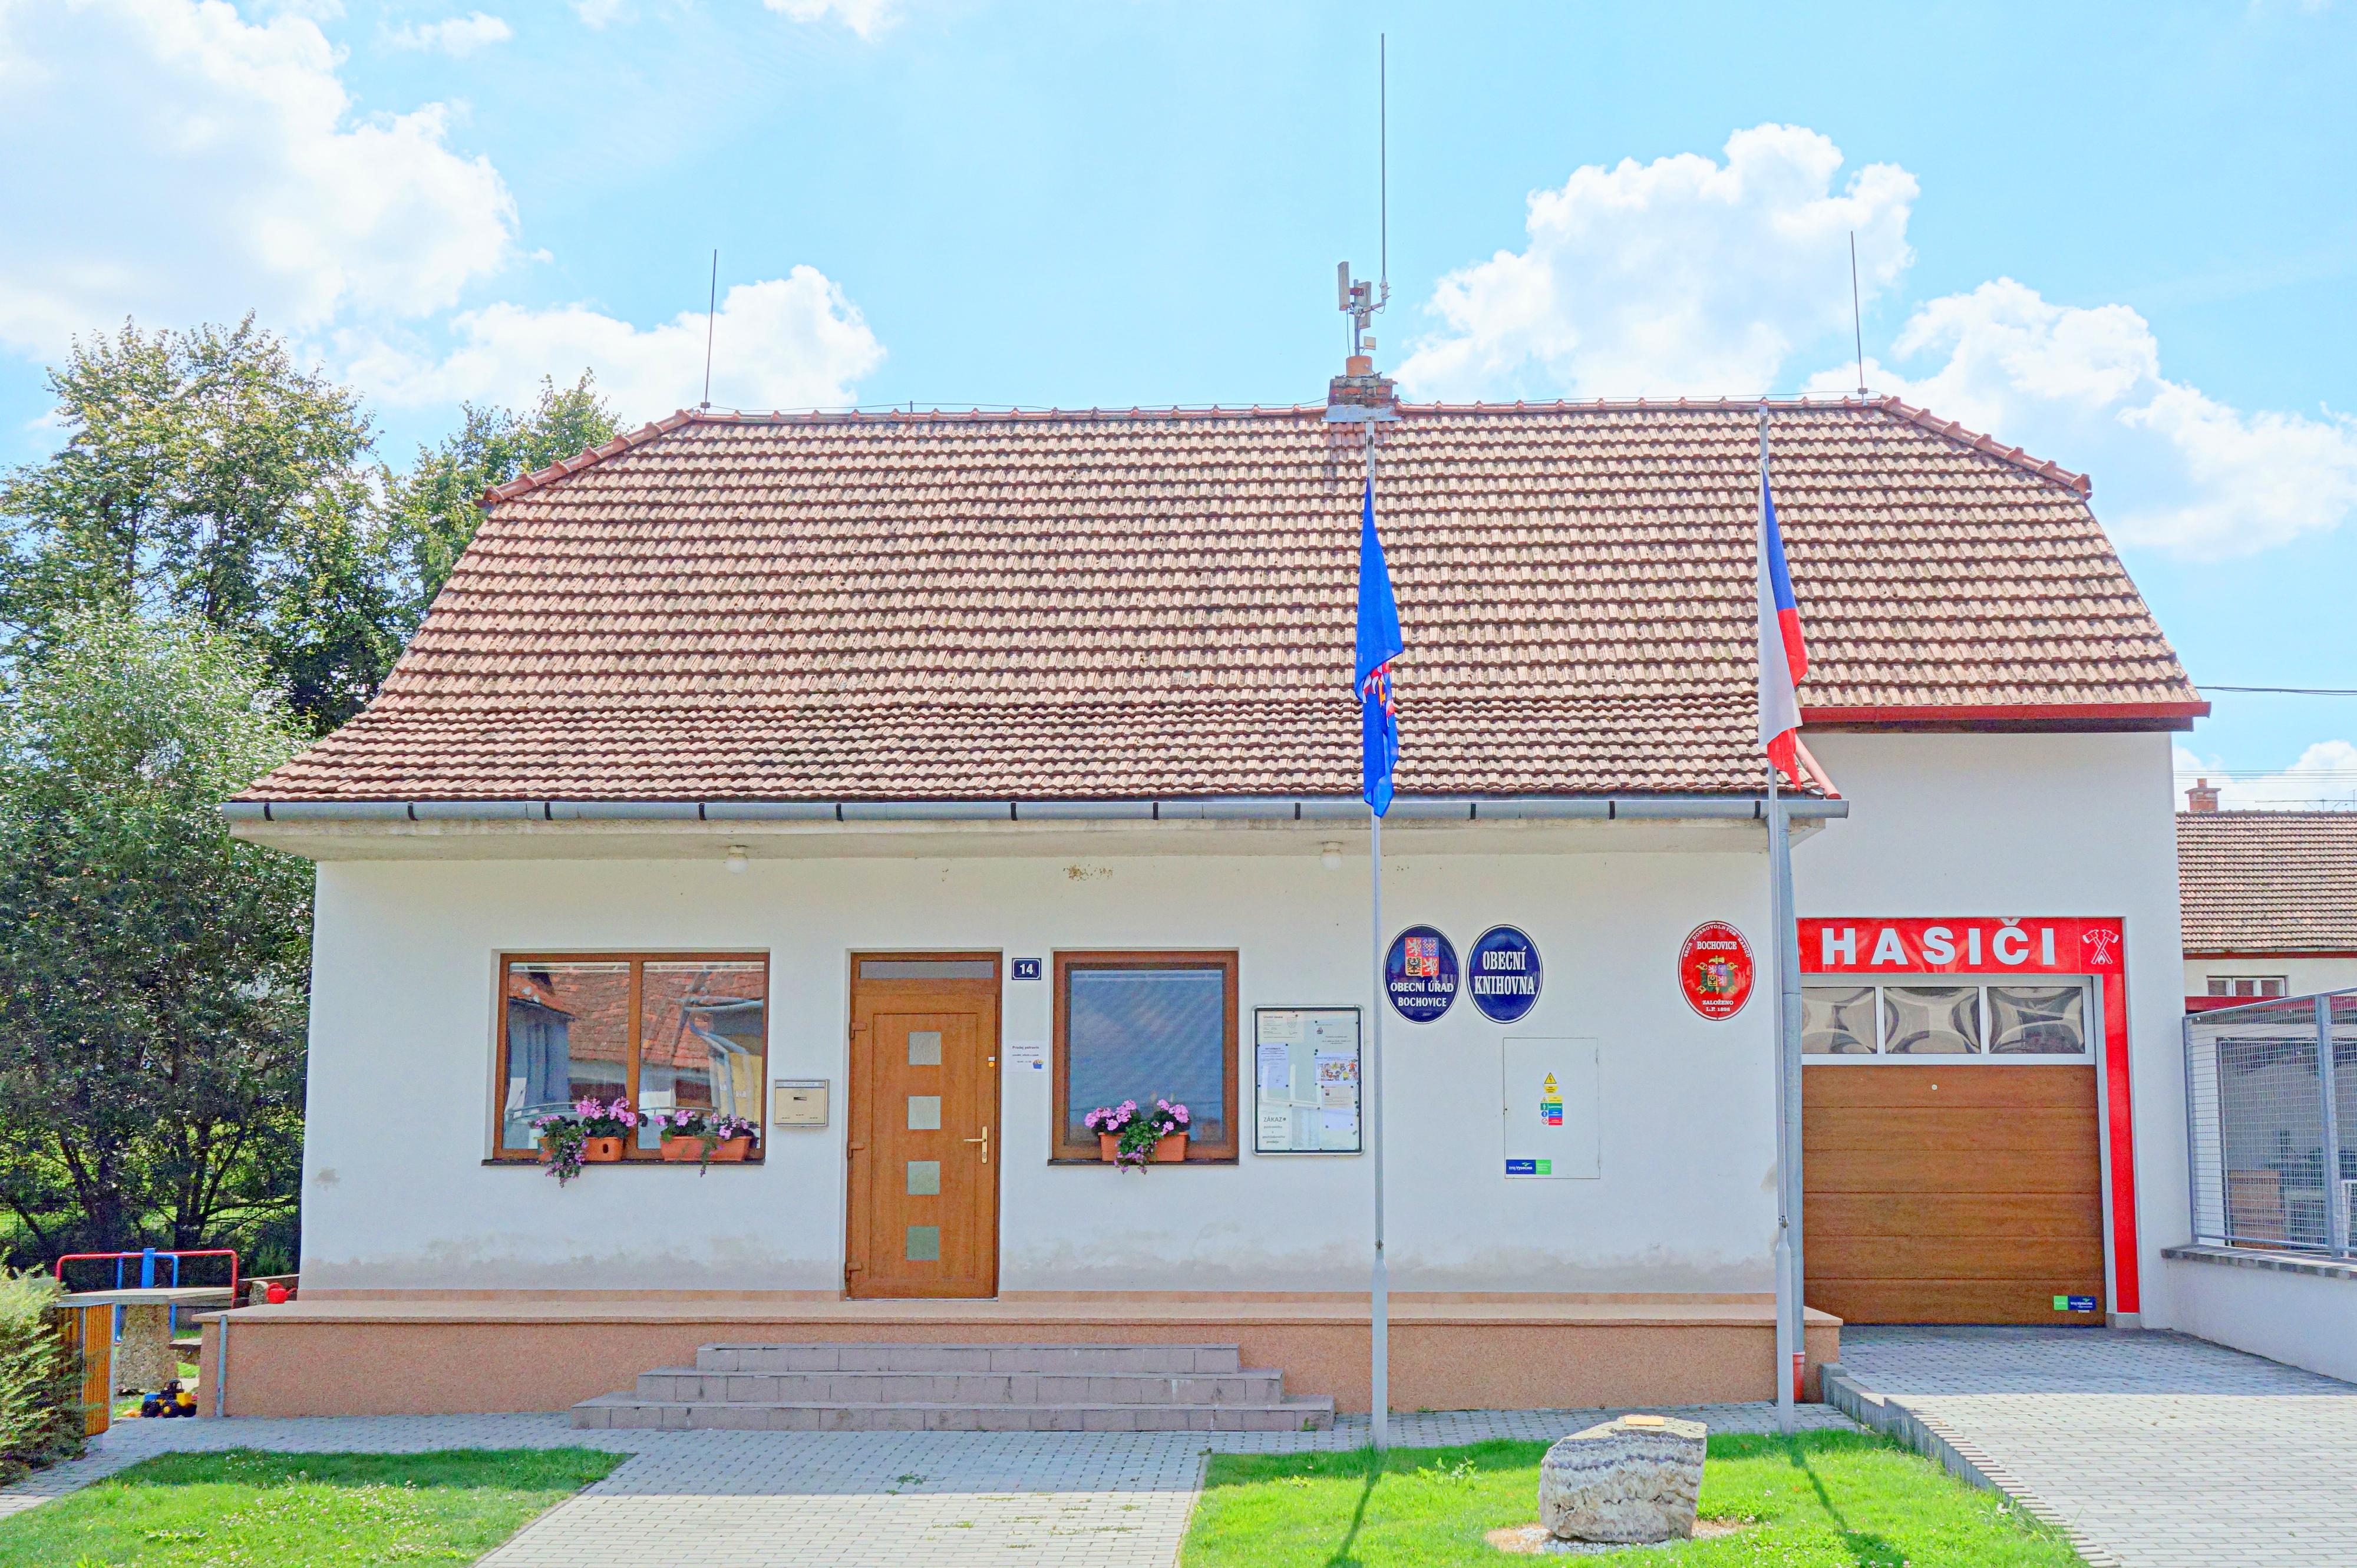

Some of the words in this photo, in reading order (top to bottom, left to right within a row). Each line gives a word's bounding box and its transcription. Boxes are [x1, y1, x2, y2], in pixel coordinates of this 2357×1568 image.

[1683, 942, 1693, 958] SBOR
[1692, 925, 1737, 941] DOBROVOLNÝCH
[1696, 941, 1738, 950] BOCHOVICE
[1821, 917, 2056, 966] HASIČI
[1482, 945, 1527, 970] OBECNÍ
[1019, 963, 1034, 975] 14
[1390, 980, 1425, 992] OBECNÍ
[1428, 981, 1454, 992] ÚŘAD
[1474, 975, 1536, 995] KNIHOVNA
[1398, 997, 1447, 1008] BOCHOVICE
